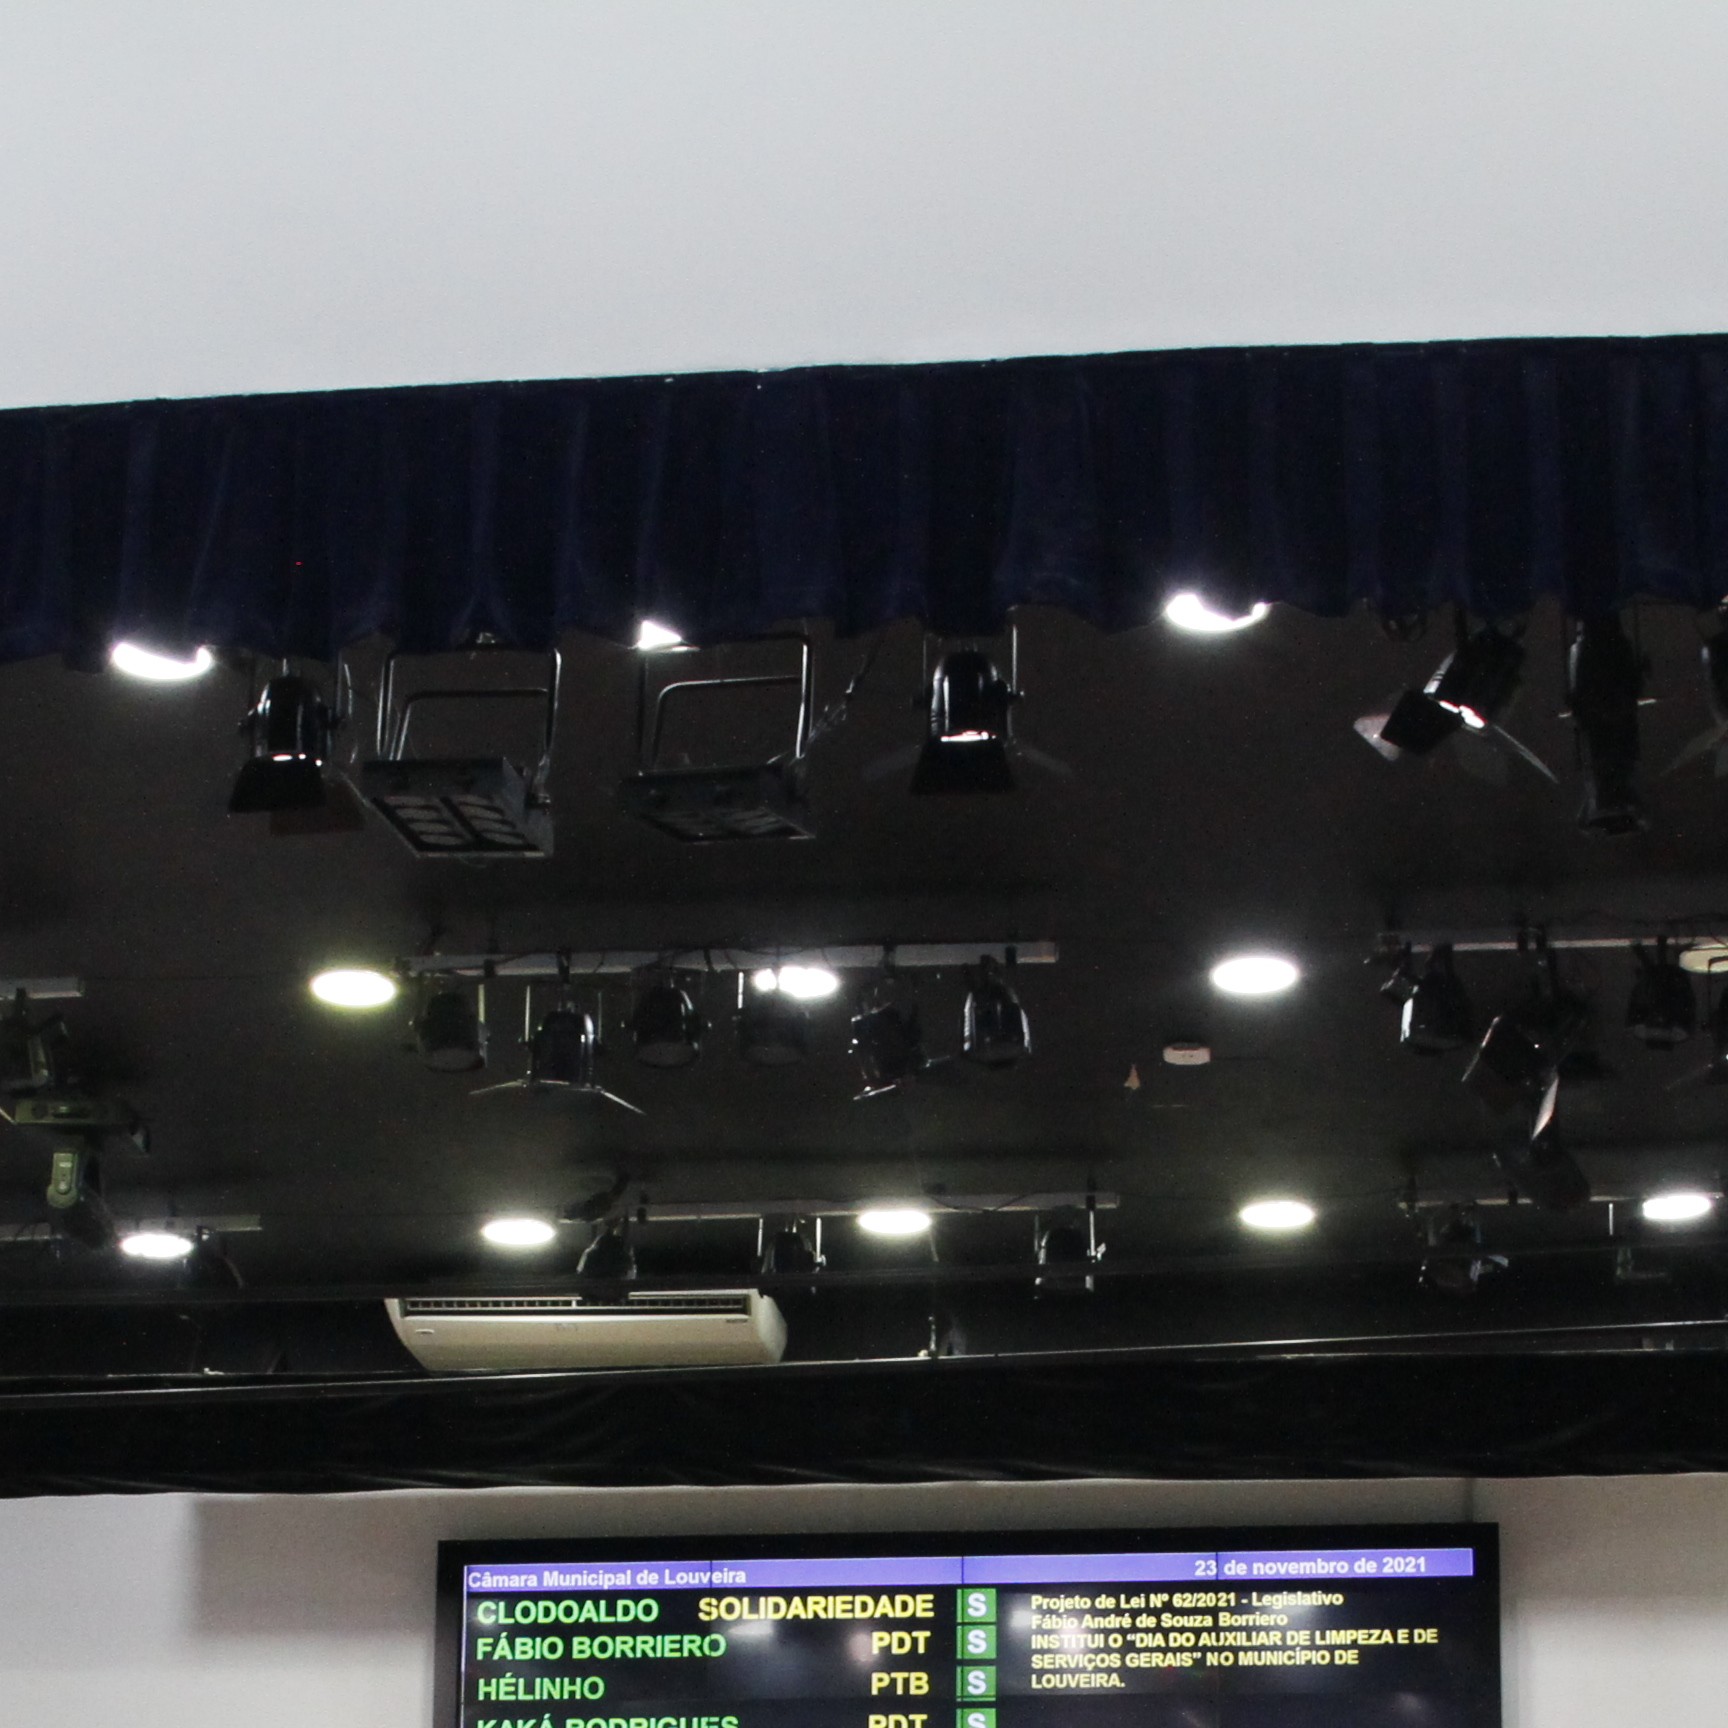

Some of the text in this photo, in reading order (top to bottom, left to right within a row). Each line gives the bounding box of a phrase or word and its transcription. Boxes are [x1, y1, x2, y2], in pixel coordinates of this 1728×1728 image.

[1195, 1557, 1426, 1576] 23 de novembro de 2021
[468, 1567, 746, 1590] Câmara Municipal de Louveira
[477, 1594, 986, 1624] CLODOALDO SOLIDARIEDADE S
[1031, 1595, 1091, 1611] Projeto
[1095, 1594, 1117, 1609] de
[1120, 1594, 1145, 1609] Lei
[1172, 1592, 1237, 1608] 62/2021
[1252, 1591, 1344, 1609] Legislativo
[1031, 1612, 1288, 1629] Fábio André de Souza Borriero
[477, 1632, 986, 1660] FÁBIO BORRIERO PDT S
[1031, 1633, 1105, 1649] INSTITUI
[1109, 1633, 1123, 1648] O
[1169, 1632, 1195, 1647] DO
[1198, 1631, 1282, 1647] AUXILIAR
[1286, 1631, 1310, 1645] DE
[1315, 1630, 1394, 1645] LIMPEZA
[1397, 1629, 1410, 1644] E
[1414, 1629, 1438, 1643] DE
[1031, 1653, 1121, 1672] SERVIÇOS
[1206, 1651, 1233, 1666] NO
[1238, 1648, 1330, 1666] MUNICÍPIO
[1334, 1650, 1359, 1665] DE
[478, 1672, 986, 1700] HÉLINHO PTB S
[1031, 1673, 1125, 1688] LOUVEIRA.
